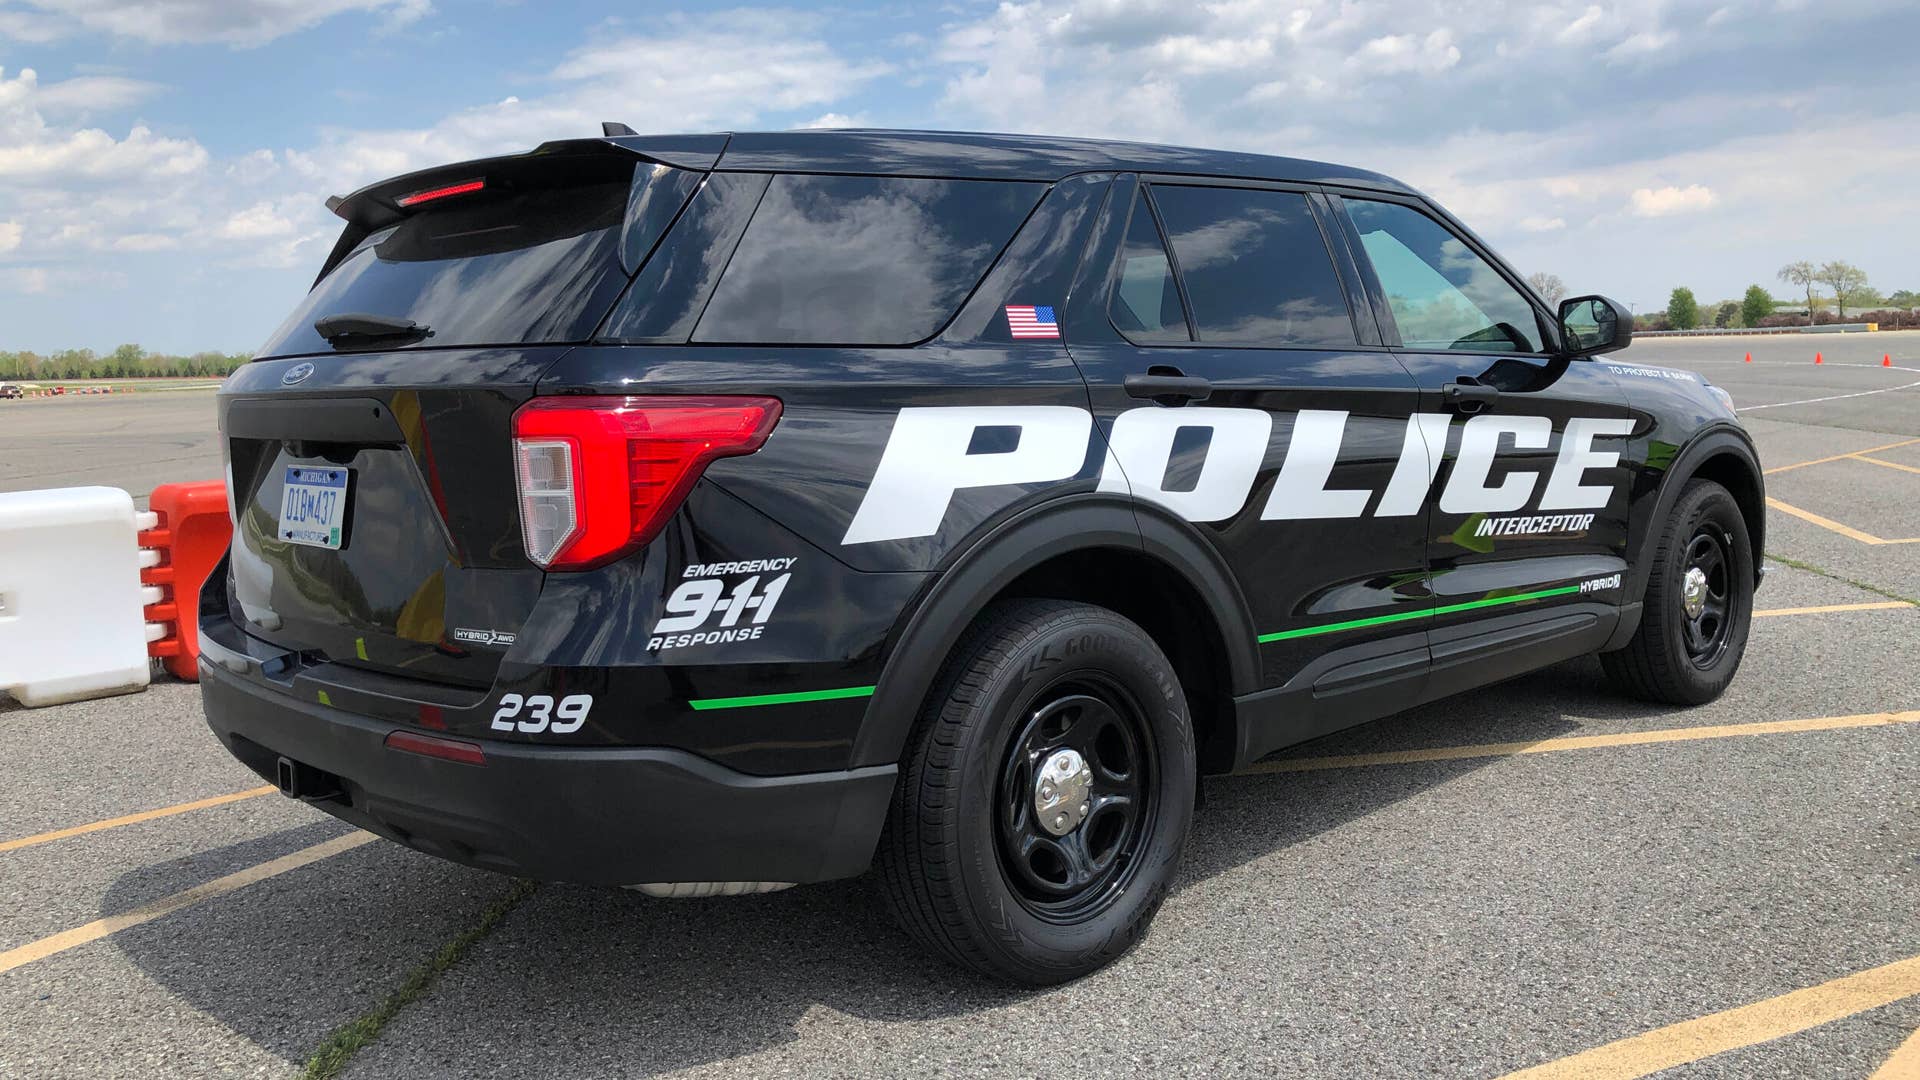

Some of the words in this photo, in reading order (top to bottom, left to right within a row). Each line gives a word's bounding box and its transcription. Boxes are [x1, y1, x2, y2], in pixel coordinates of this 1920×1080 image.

[1608, 366, 1623, 375] TO
[1623, 367, 1661, 378] PROTECT
[300, 471, 331, 484] MICHIGAN
[841, 405, 1637, 545] POLICE
[1474, 513, 1595, 537] INTERCEPTOR
[682, 556, 798, 578] EMERGENCY
[1580, 577, 1613, 594] HYBRID
[653, 572, 792, 634] 9-1-1
[456, 630, 489, 642] HYBRID
[497, 634, 516, 643] AWD
[646, 626, 765, 651] RESPONSE
[490, 693, 594, 734] 239
